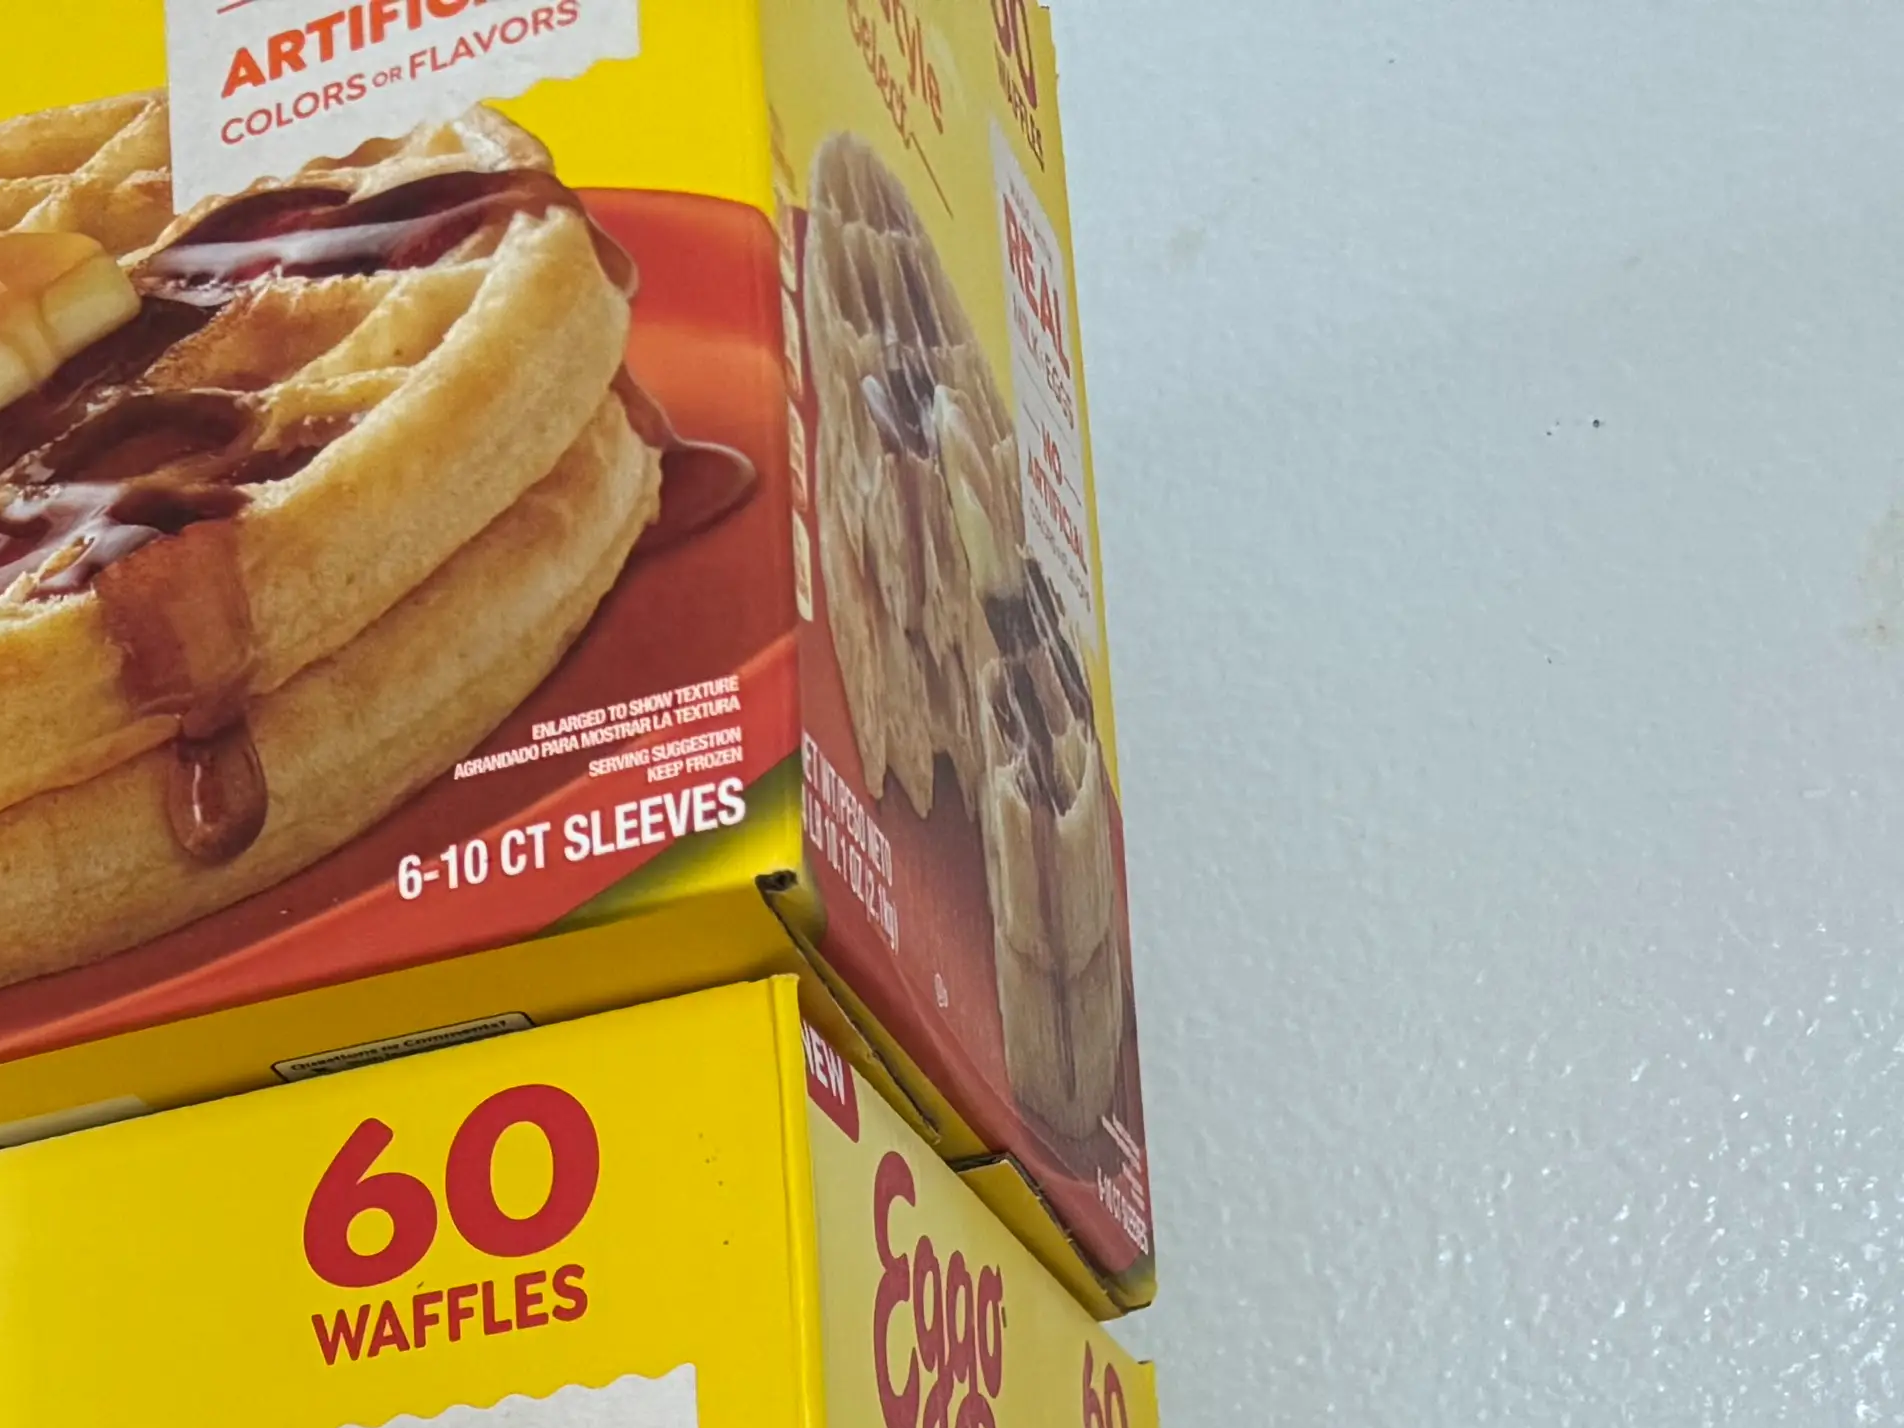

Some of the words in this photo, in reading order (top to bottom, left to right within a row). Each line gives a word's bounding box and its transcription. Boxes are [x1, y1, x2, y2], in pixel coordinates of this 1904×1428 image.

[220, 73, 368, 146] COLORS
[372, 65, 403, 89] OR
[409, 0, 580, 81] FLAVORS
[304, 1084, 599, 1287] 60
[312, 1264, 587, 1365] WAFFLES
